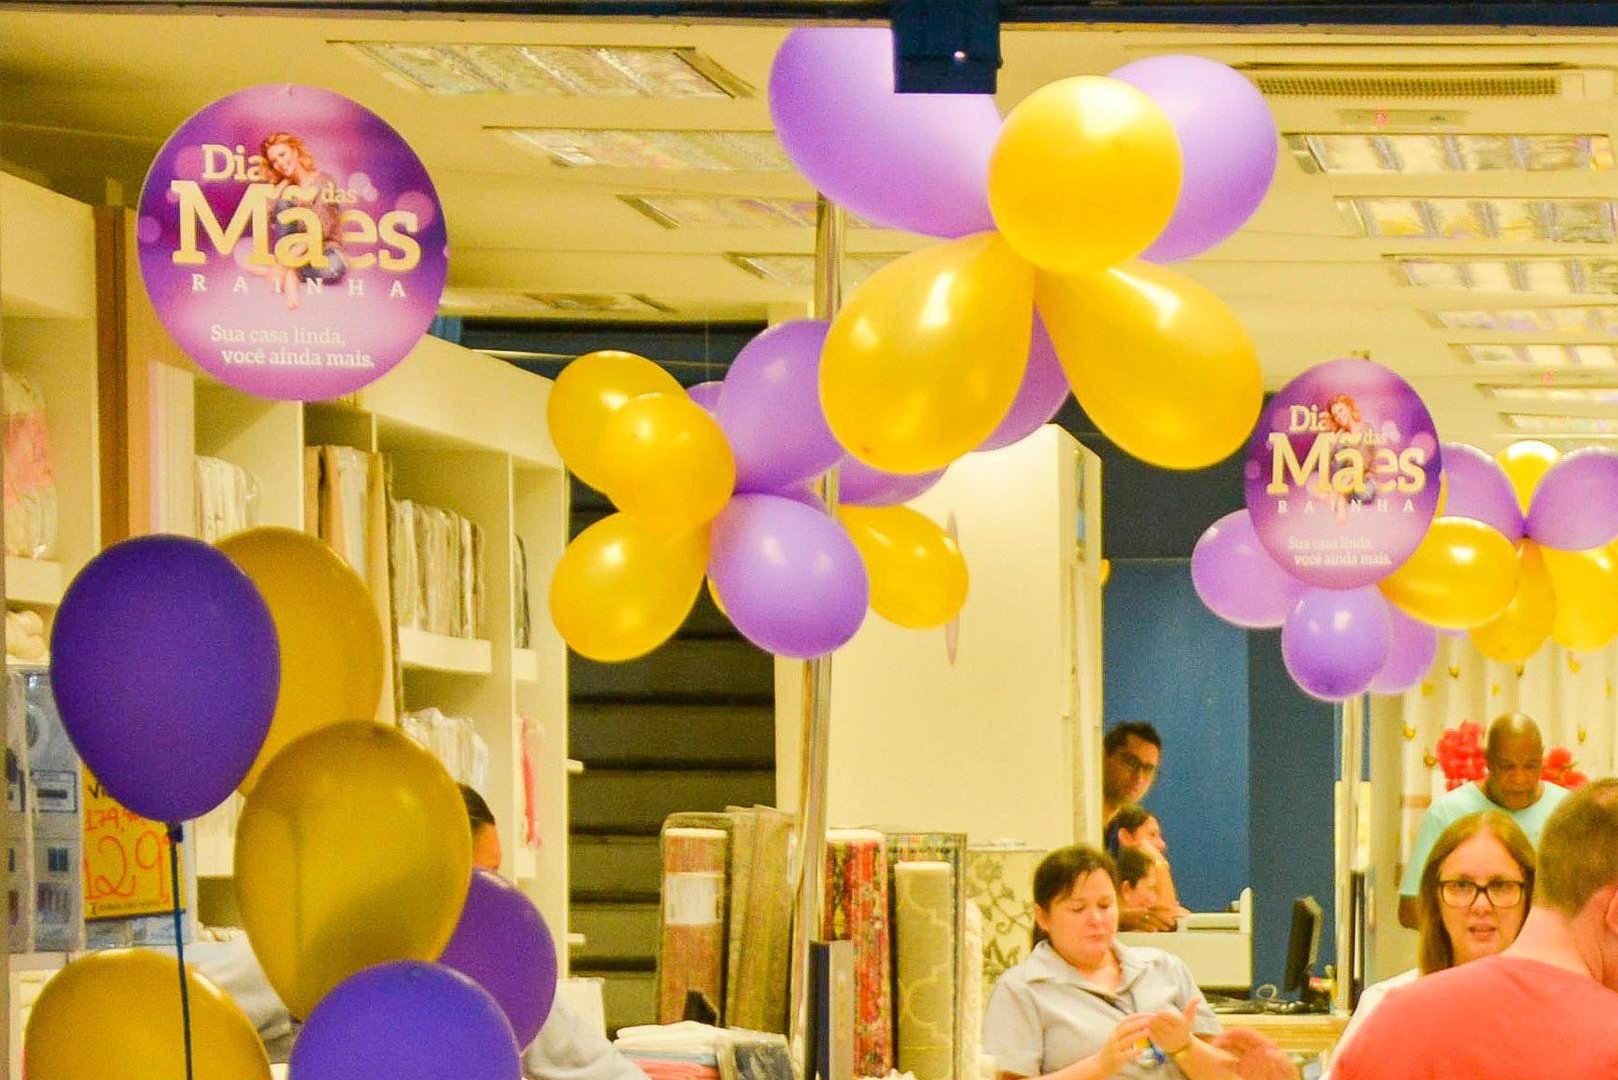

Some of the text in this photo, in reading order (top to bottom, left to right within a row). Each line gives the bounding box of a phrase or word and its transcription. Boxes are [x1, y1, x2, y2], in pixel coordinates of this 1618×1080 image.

[202, 143, 265, 182] Dia
[320, 183, 357, 204] das
[170, 180, 421, 272] Mães
[191, 273, 406, 298] RAINHA
[211, 323, 346, 347] Sua casa linda,
[222, 348, 375, 368] você ainda mais.
[1289, 404, 1331, 432] Dia
[1266, 432, 1426, 495] Mães
